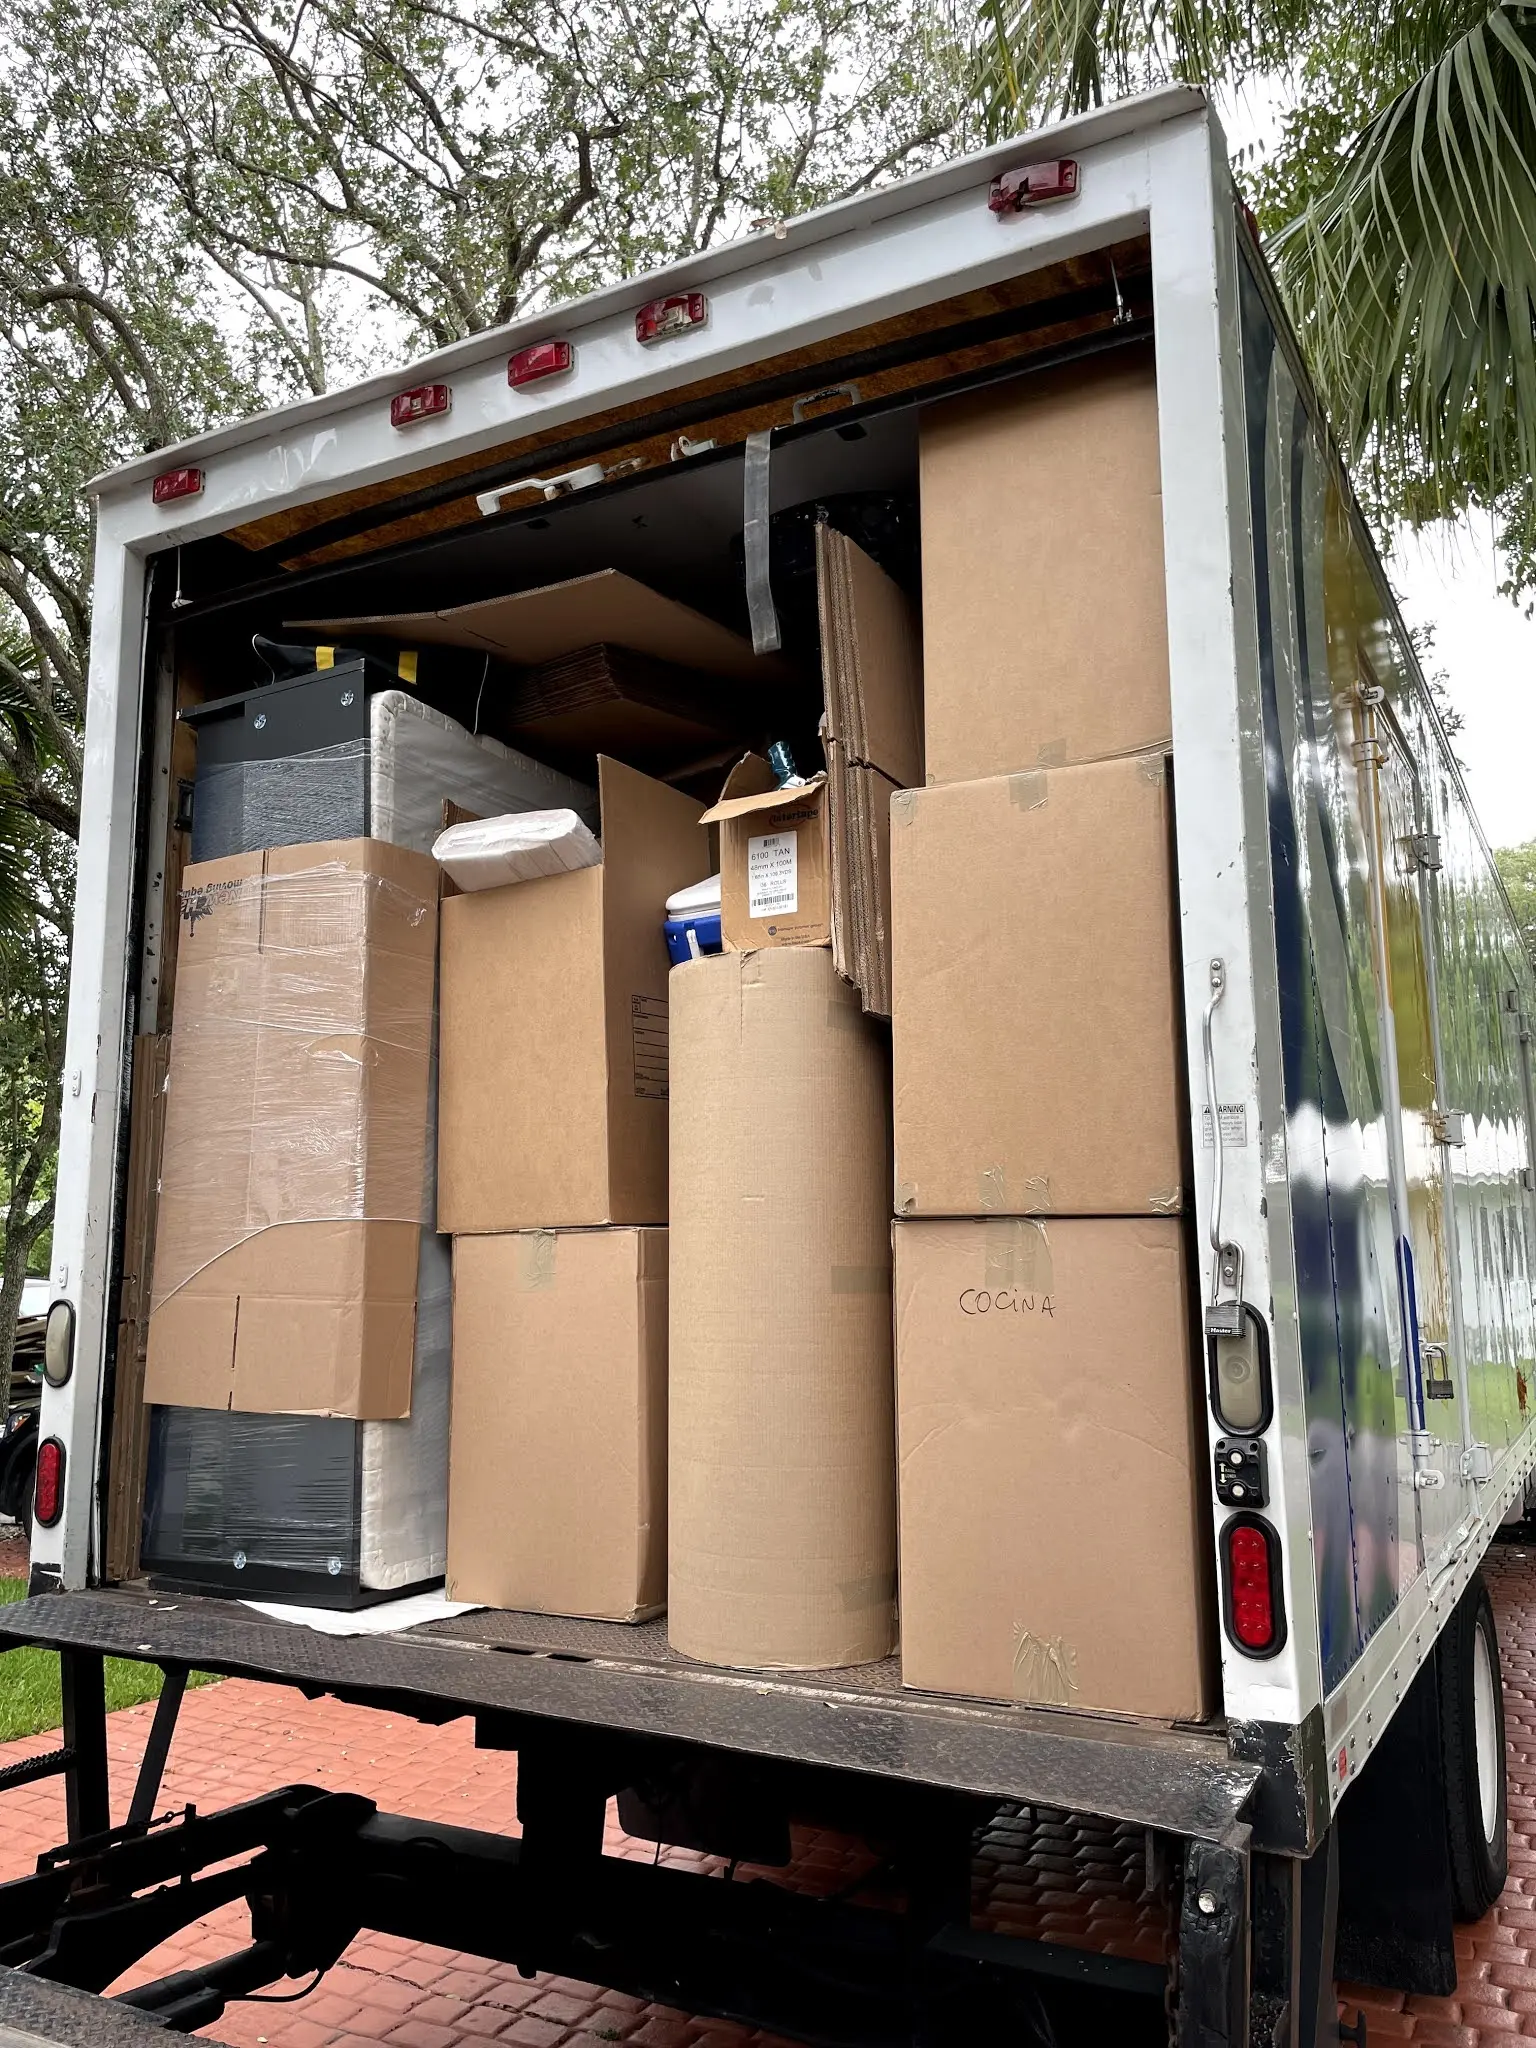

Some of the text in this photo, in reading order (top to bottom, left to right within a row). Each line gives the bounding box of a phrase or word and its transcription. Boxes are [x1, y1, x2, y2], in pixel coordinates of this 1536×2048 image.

[751, 848, 790, 861] 6100 TAN
[769, 861, 775, 869] X
[205, 879, 242, 894] moving
